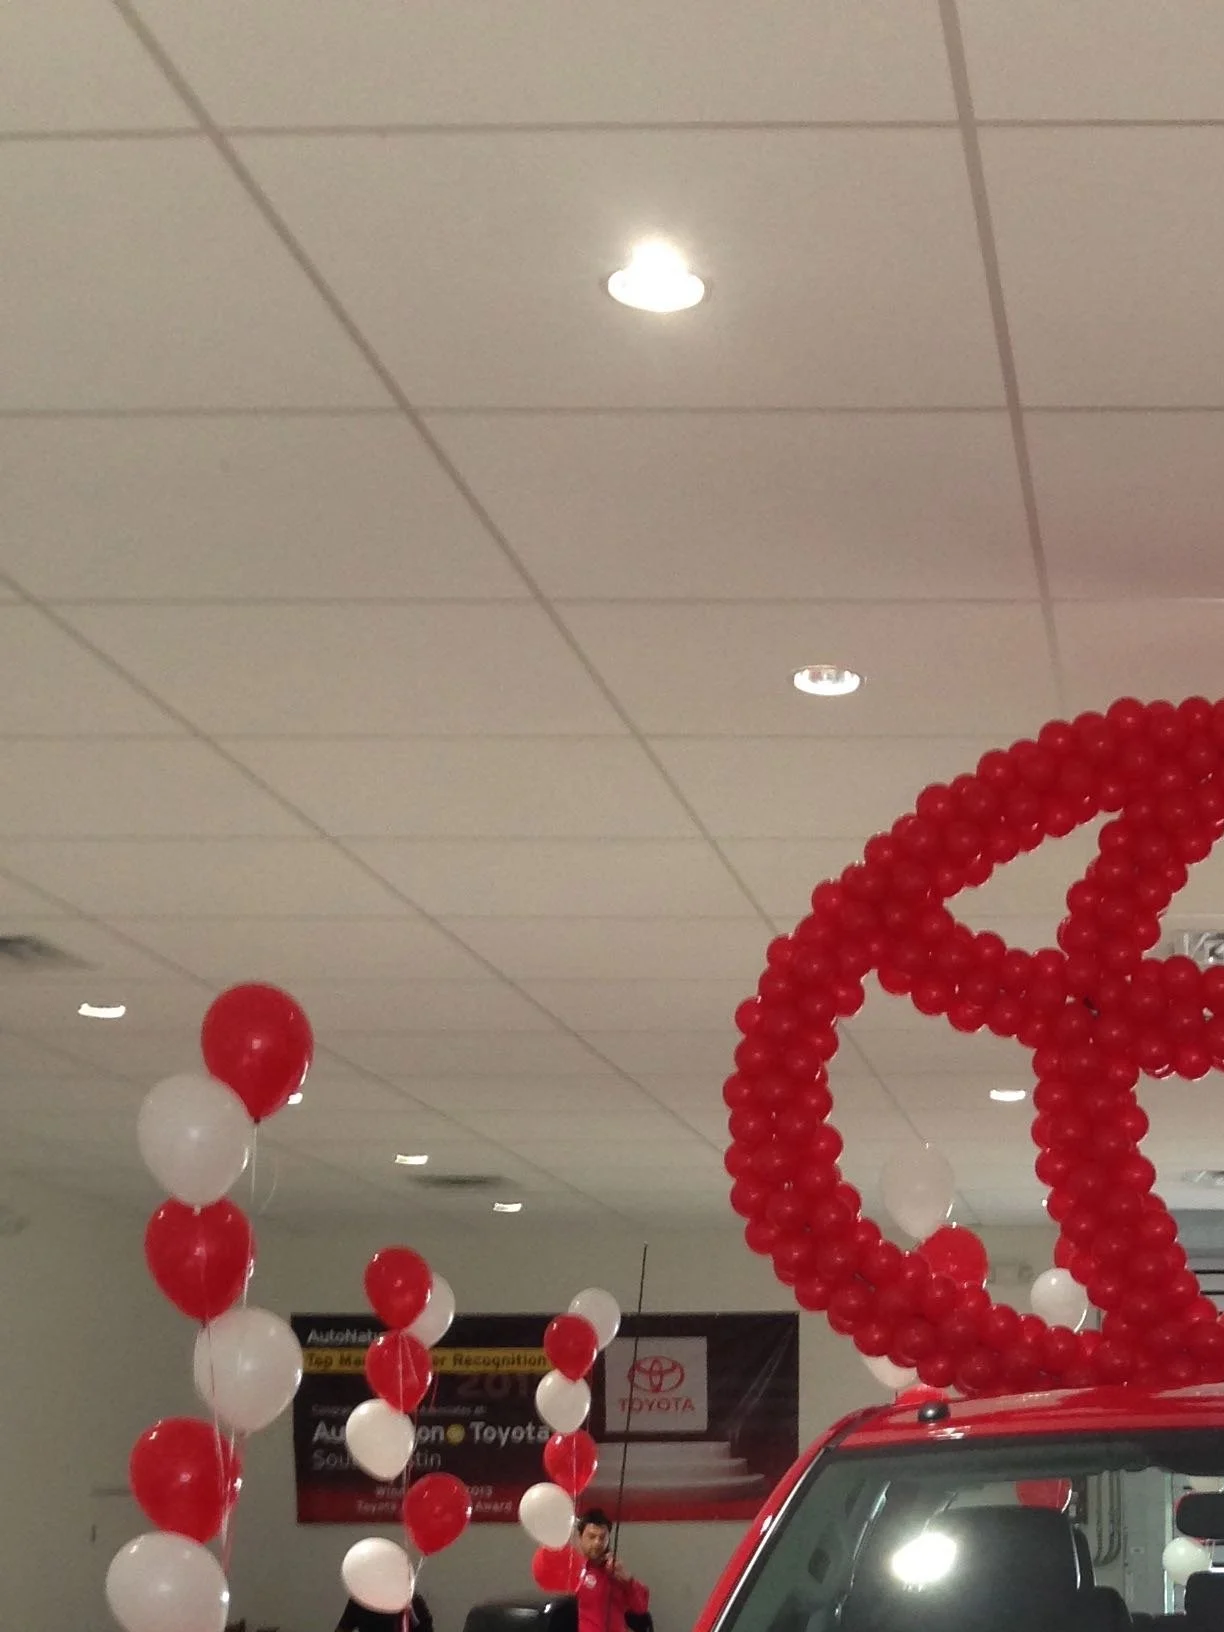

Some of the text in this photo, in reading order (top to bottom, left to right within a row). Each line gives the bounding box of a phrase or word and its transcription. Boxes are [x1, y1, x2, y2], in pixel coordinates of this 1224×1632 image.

[307, 1328, 377, 1345] AutoNat
[453, 1353, 547, 1368] Recognition
[619, 1397, 695, 1412] TOYOTA
[469, 1421, 550, 1447] Toyota
